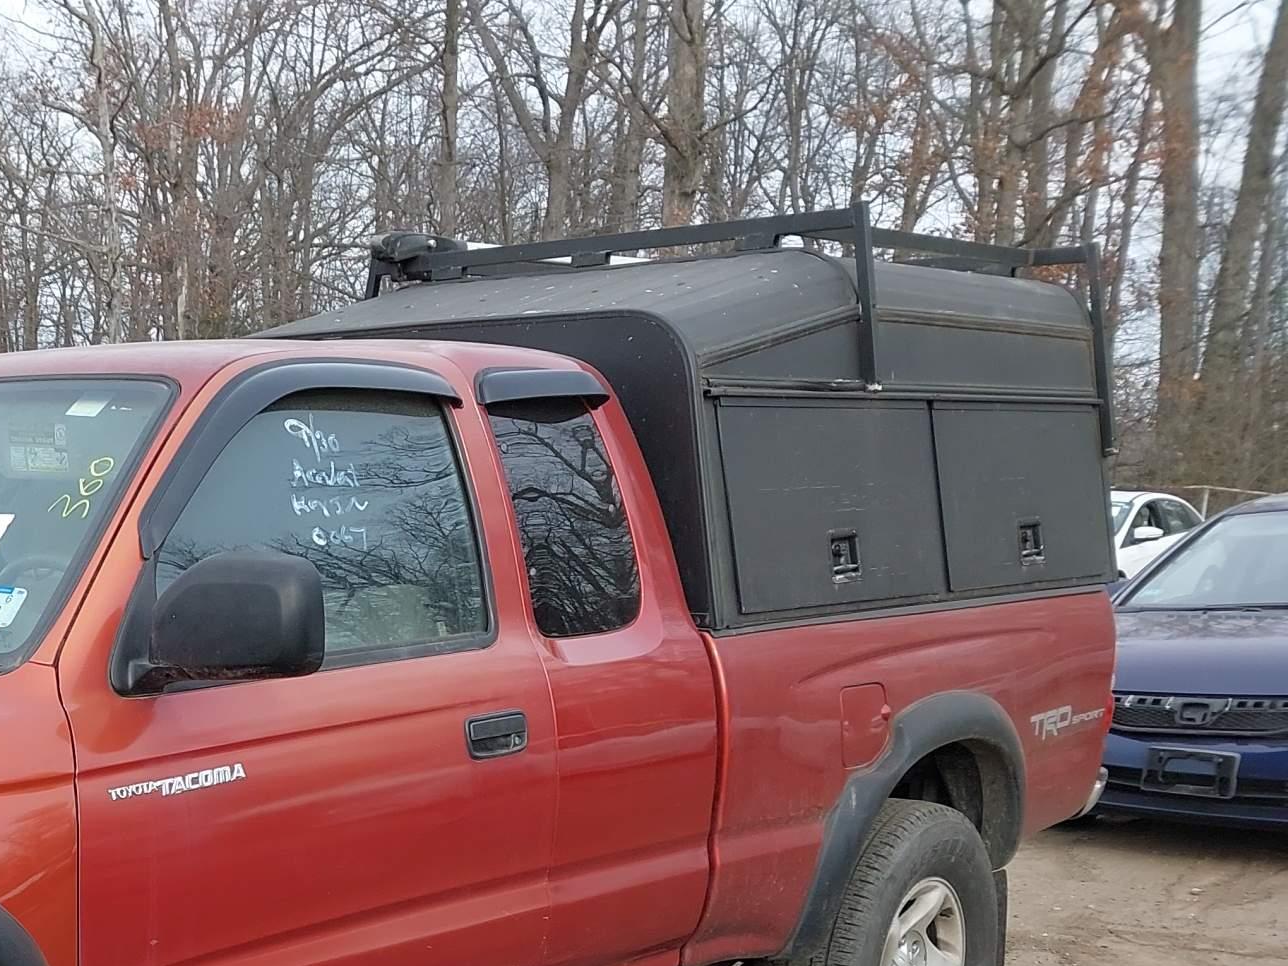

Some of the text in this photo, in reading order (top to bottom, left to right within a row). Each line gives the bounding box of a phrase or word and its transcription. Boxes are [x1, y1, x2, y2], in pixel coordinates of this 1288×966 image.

[48, 456, 115, 518] 360
[1030, 705, 1106, 741] TRD SPORT
[108, 762, 247, 801] TOYOTA TACOMA
